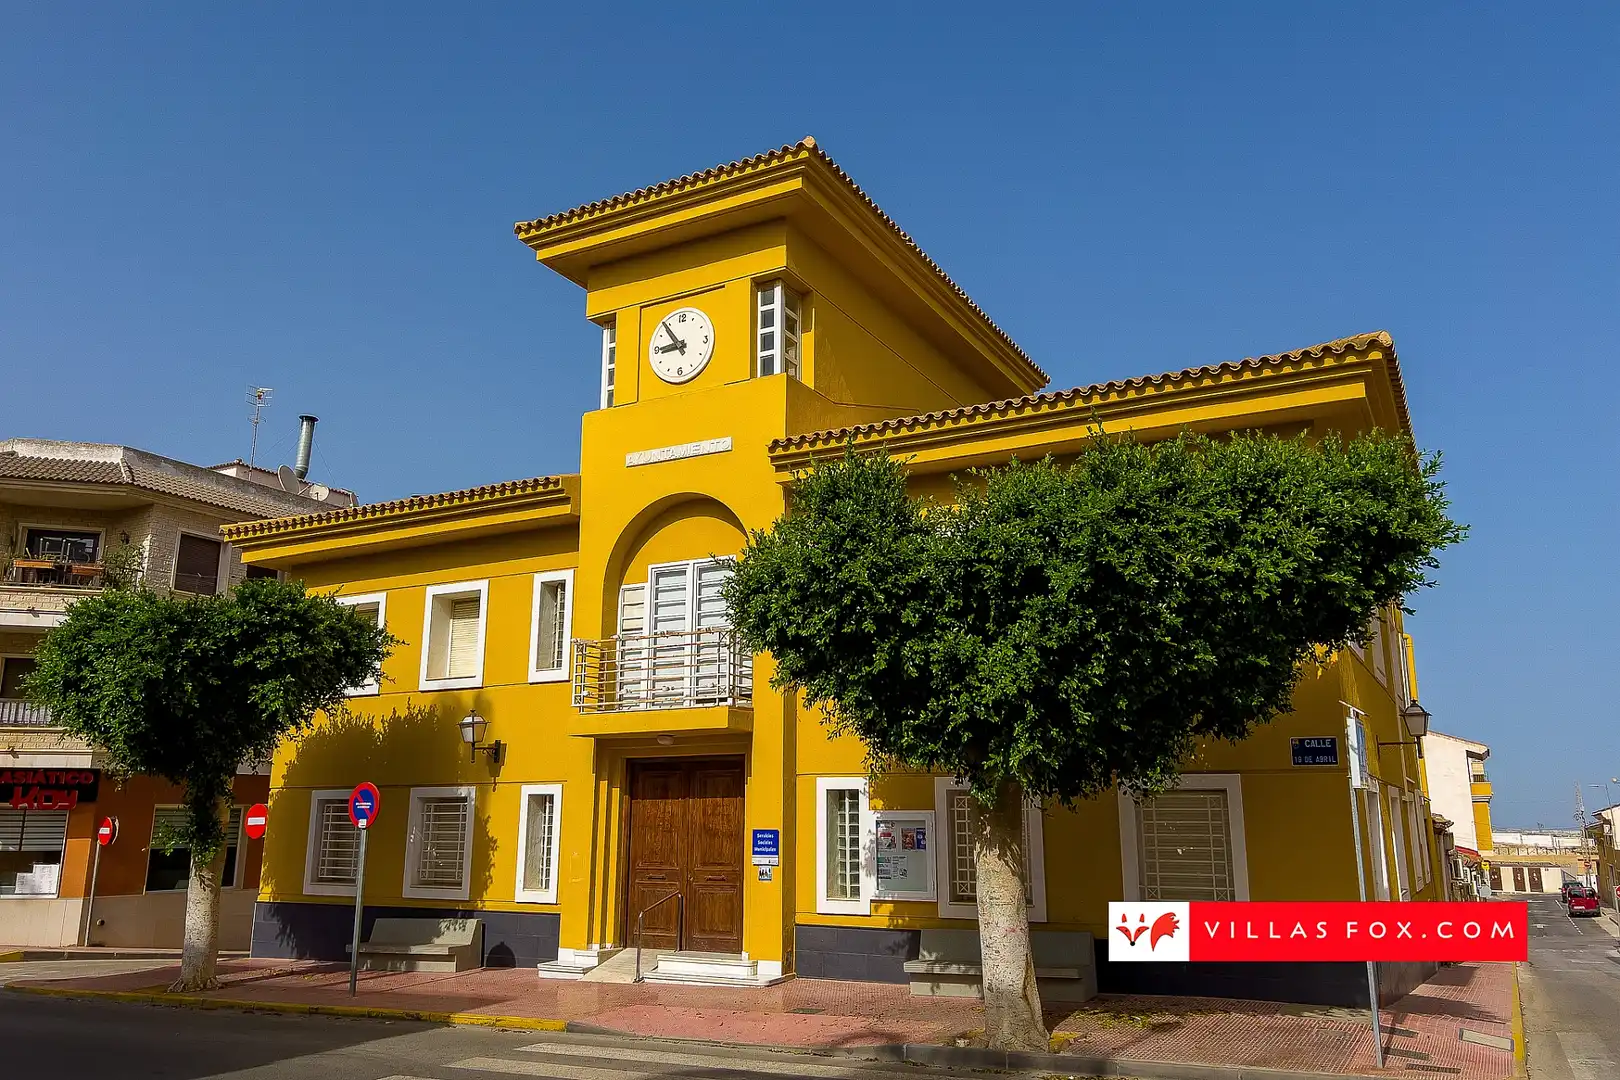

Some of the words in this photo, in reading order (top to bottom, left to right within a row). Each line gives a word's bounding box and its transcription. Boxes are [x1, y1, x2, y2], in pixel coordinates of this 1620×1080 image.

[678, 313, 687, 324] 12
[702, 334, 709, 345] 3
[653, 345, 660, 355] 9
[676, 366, 684, 376] 6
[626, 439, 731, 465] AYUNTAMIENTO
[1304, 738, 1332, 748] CALLE
[1304, 755, 1313, 763] DE
[1315, 755, 1336, 763] ABRIL
